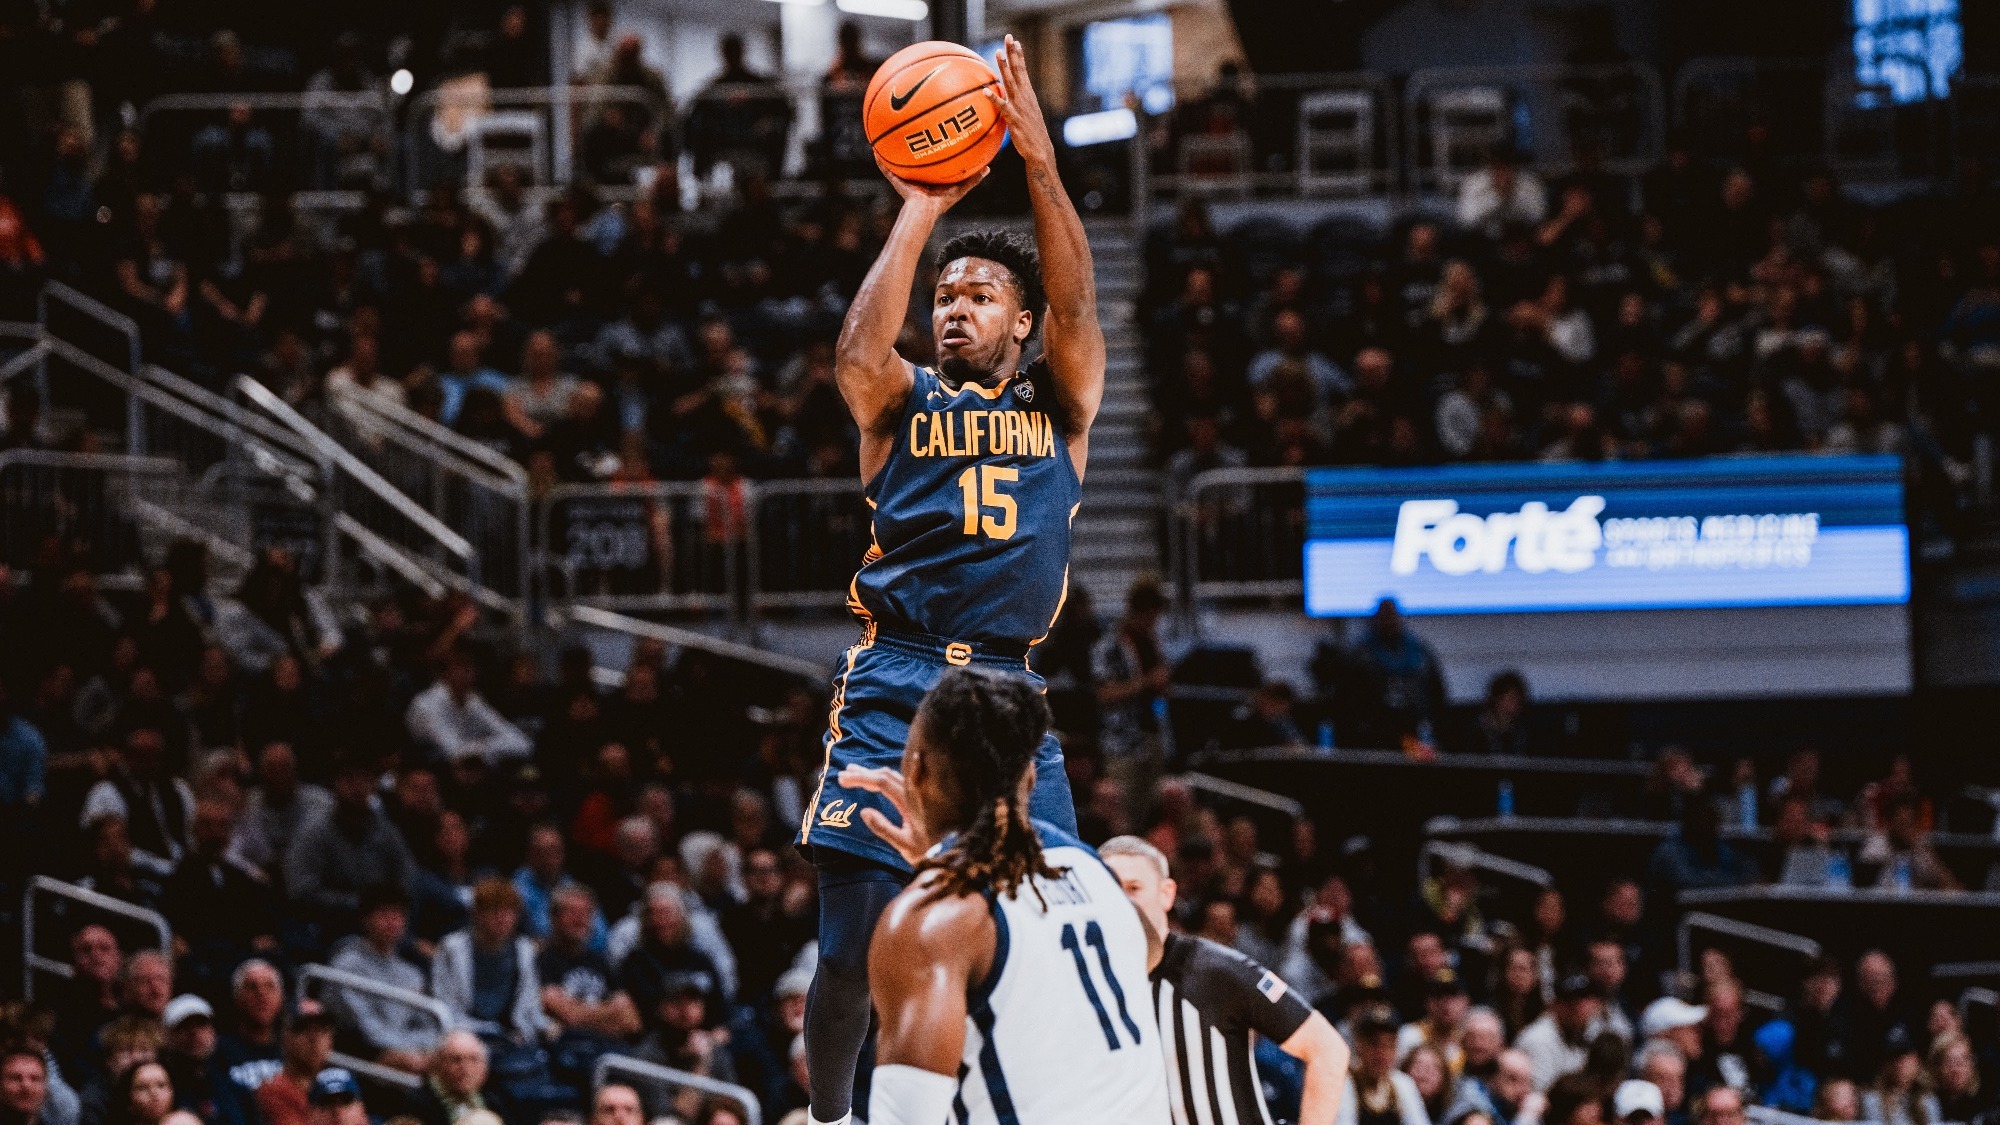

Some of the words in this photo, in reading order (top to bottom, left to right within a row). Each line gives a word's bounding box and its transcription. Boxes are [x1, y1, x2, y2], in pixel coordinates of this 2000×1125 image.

[905, 105, 979, 153] ELITE
[913, 122, 983, 160] CHAMPIONSHIP
[910, 410, 1056, 458] CALIFORNIA
[958, 464, 1019, 541] 15
[1391, 496, 1605, 575] Forté
[818, 799, 858, 828] Cal
[1060, 920, 1142, 1052] 11
